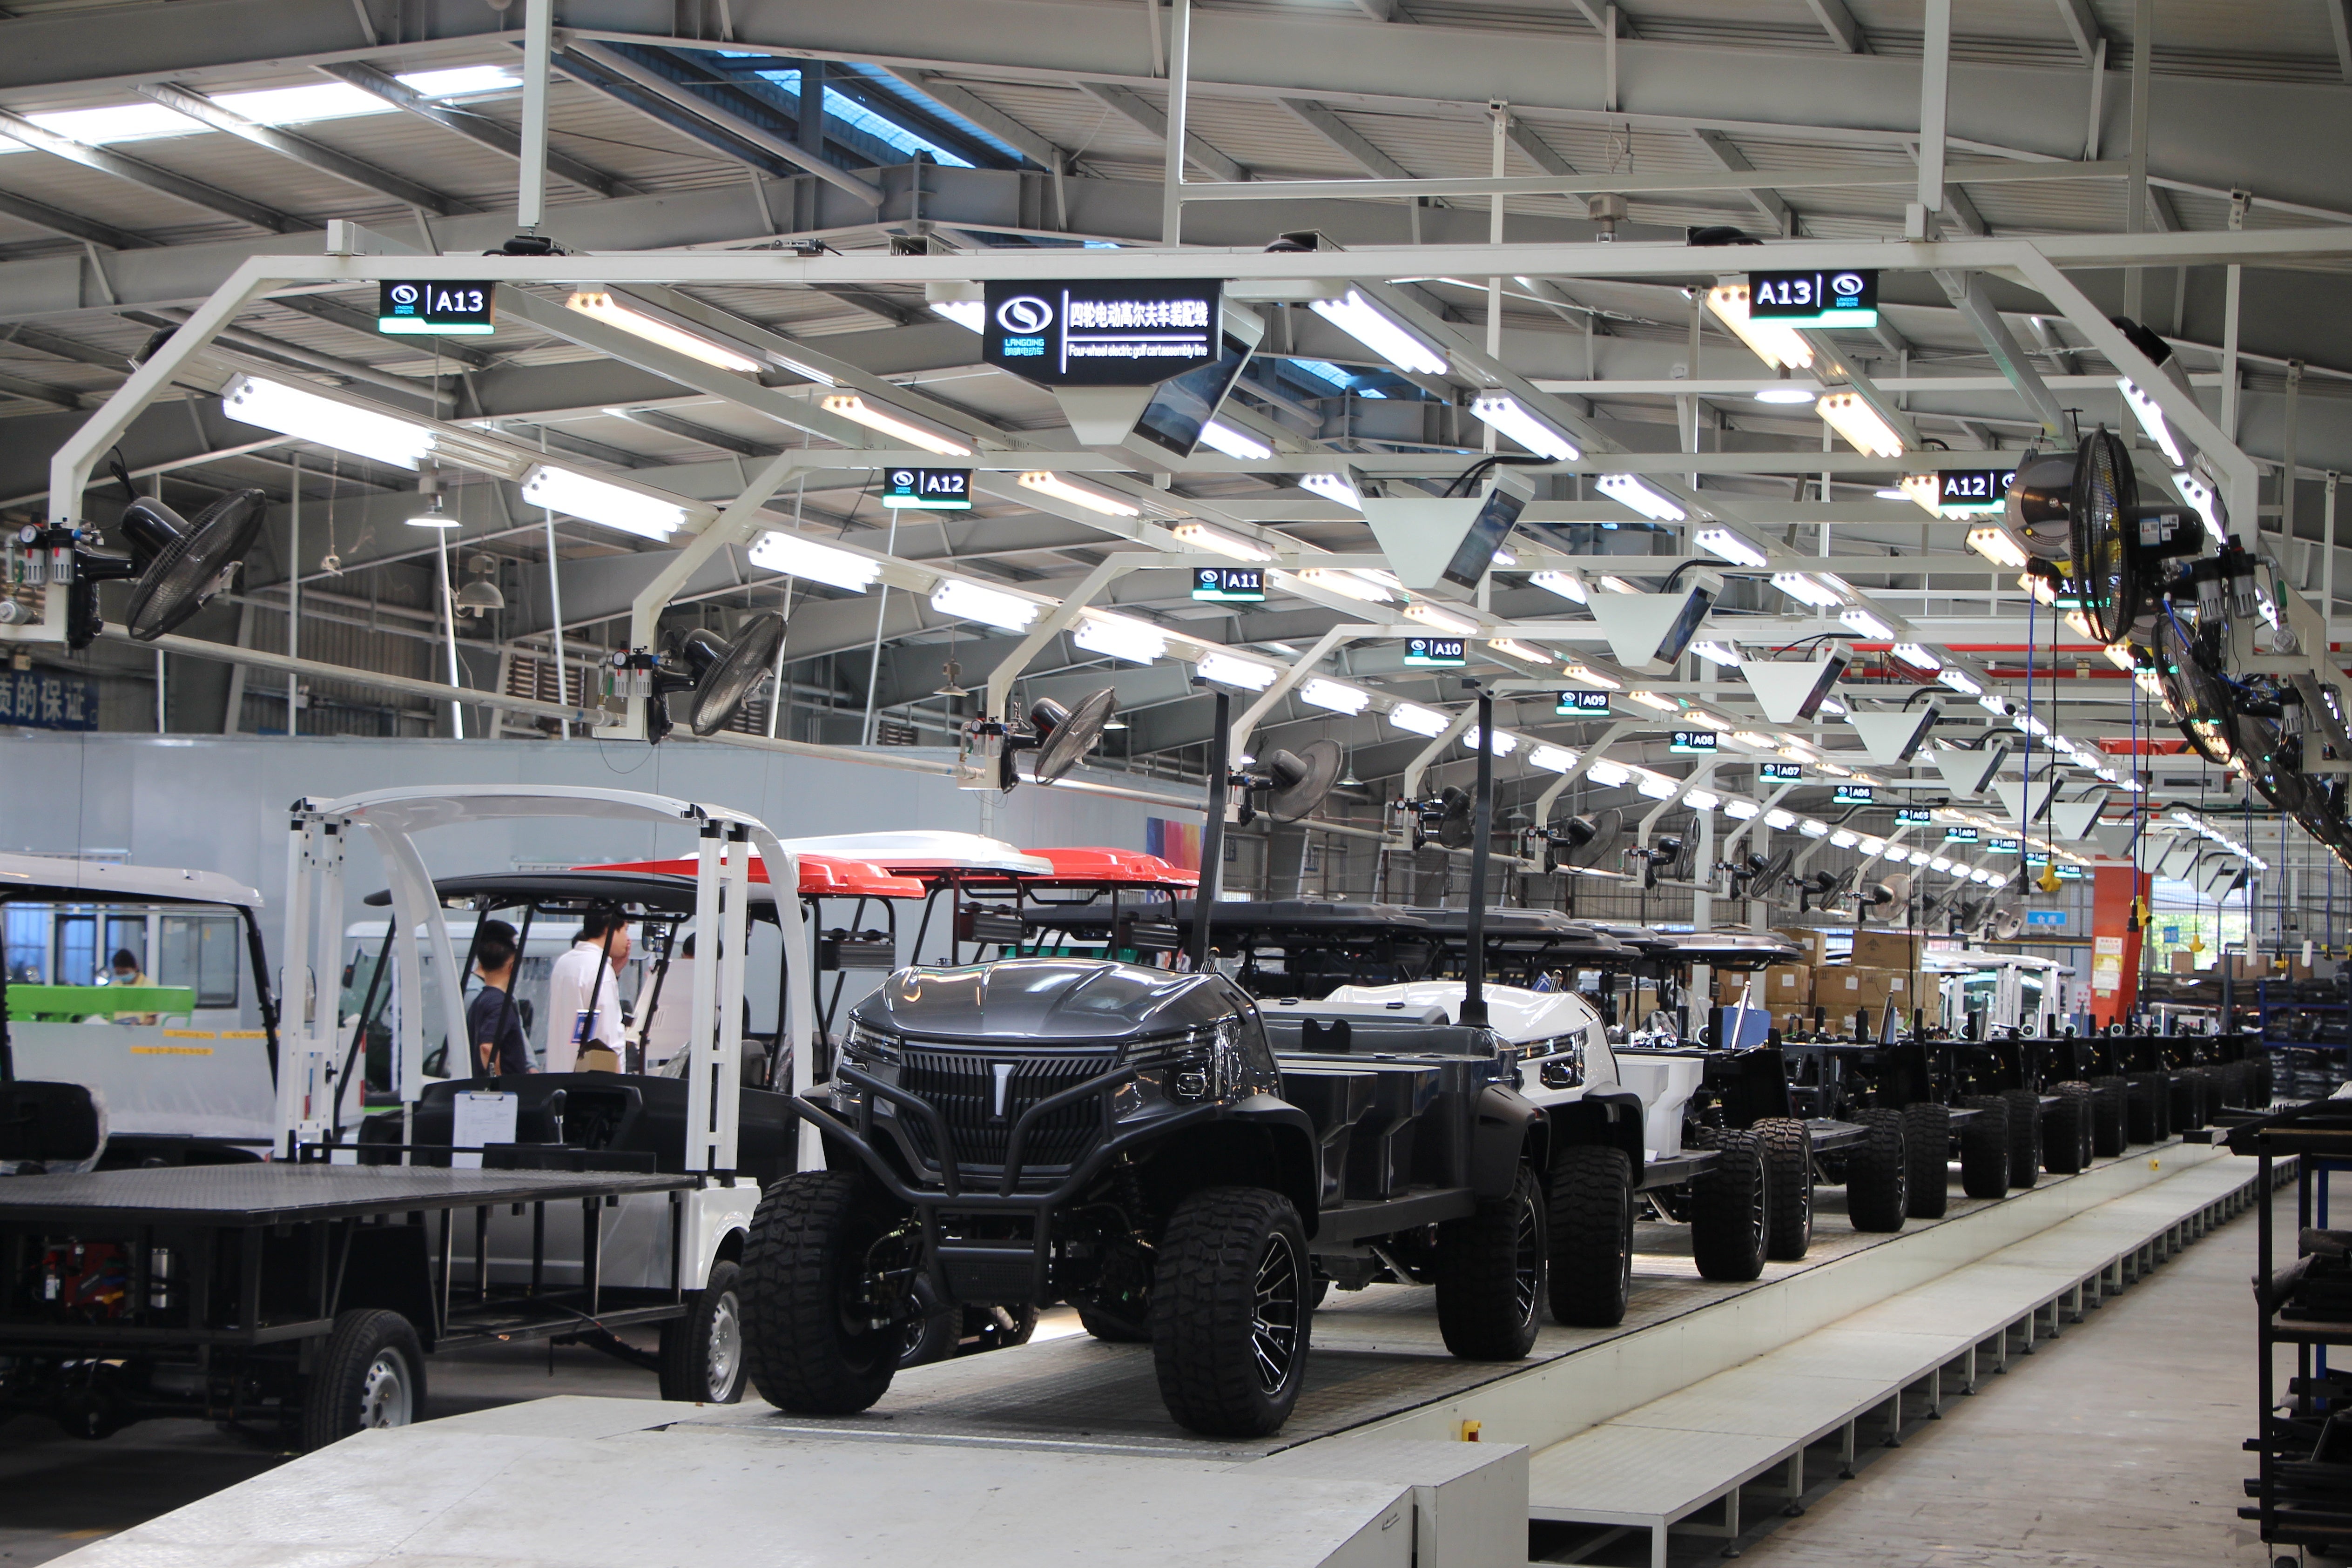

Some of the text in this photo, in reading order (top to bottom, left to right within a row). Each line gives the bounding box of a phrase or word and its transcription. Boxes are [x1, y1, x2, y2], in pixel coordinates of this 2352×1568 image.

[1756, 280, 1812, 305] A13
[435, 290, 484, 312] A13
[1070, 301, 1209, 328] 四轮电动高尔夫车装配线
[1068, 344, 1208, 359] Four-wheel electric golf cart assembly line
[926, 475, 964, 493] A12
[1944, 477, 1986, 496] A12
[1228, 573, 1260, 588] A11
[1435, 643, 1462, 656] A10
[1583, 694, 1606, 706] A09
[1693, 735, 1714, 745] A08
[1781, 766, 1800, 776] A07
[1853, 788, 1870, 797] A06
